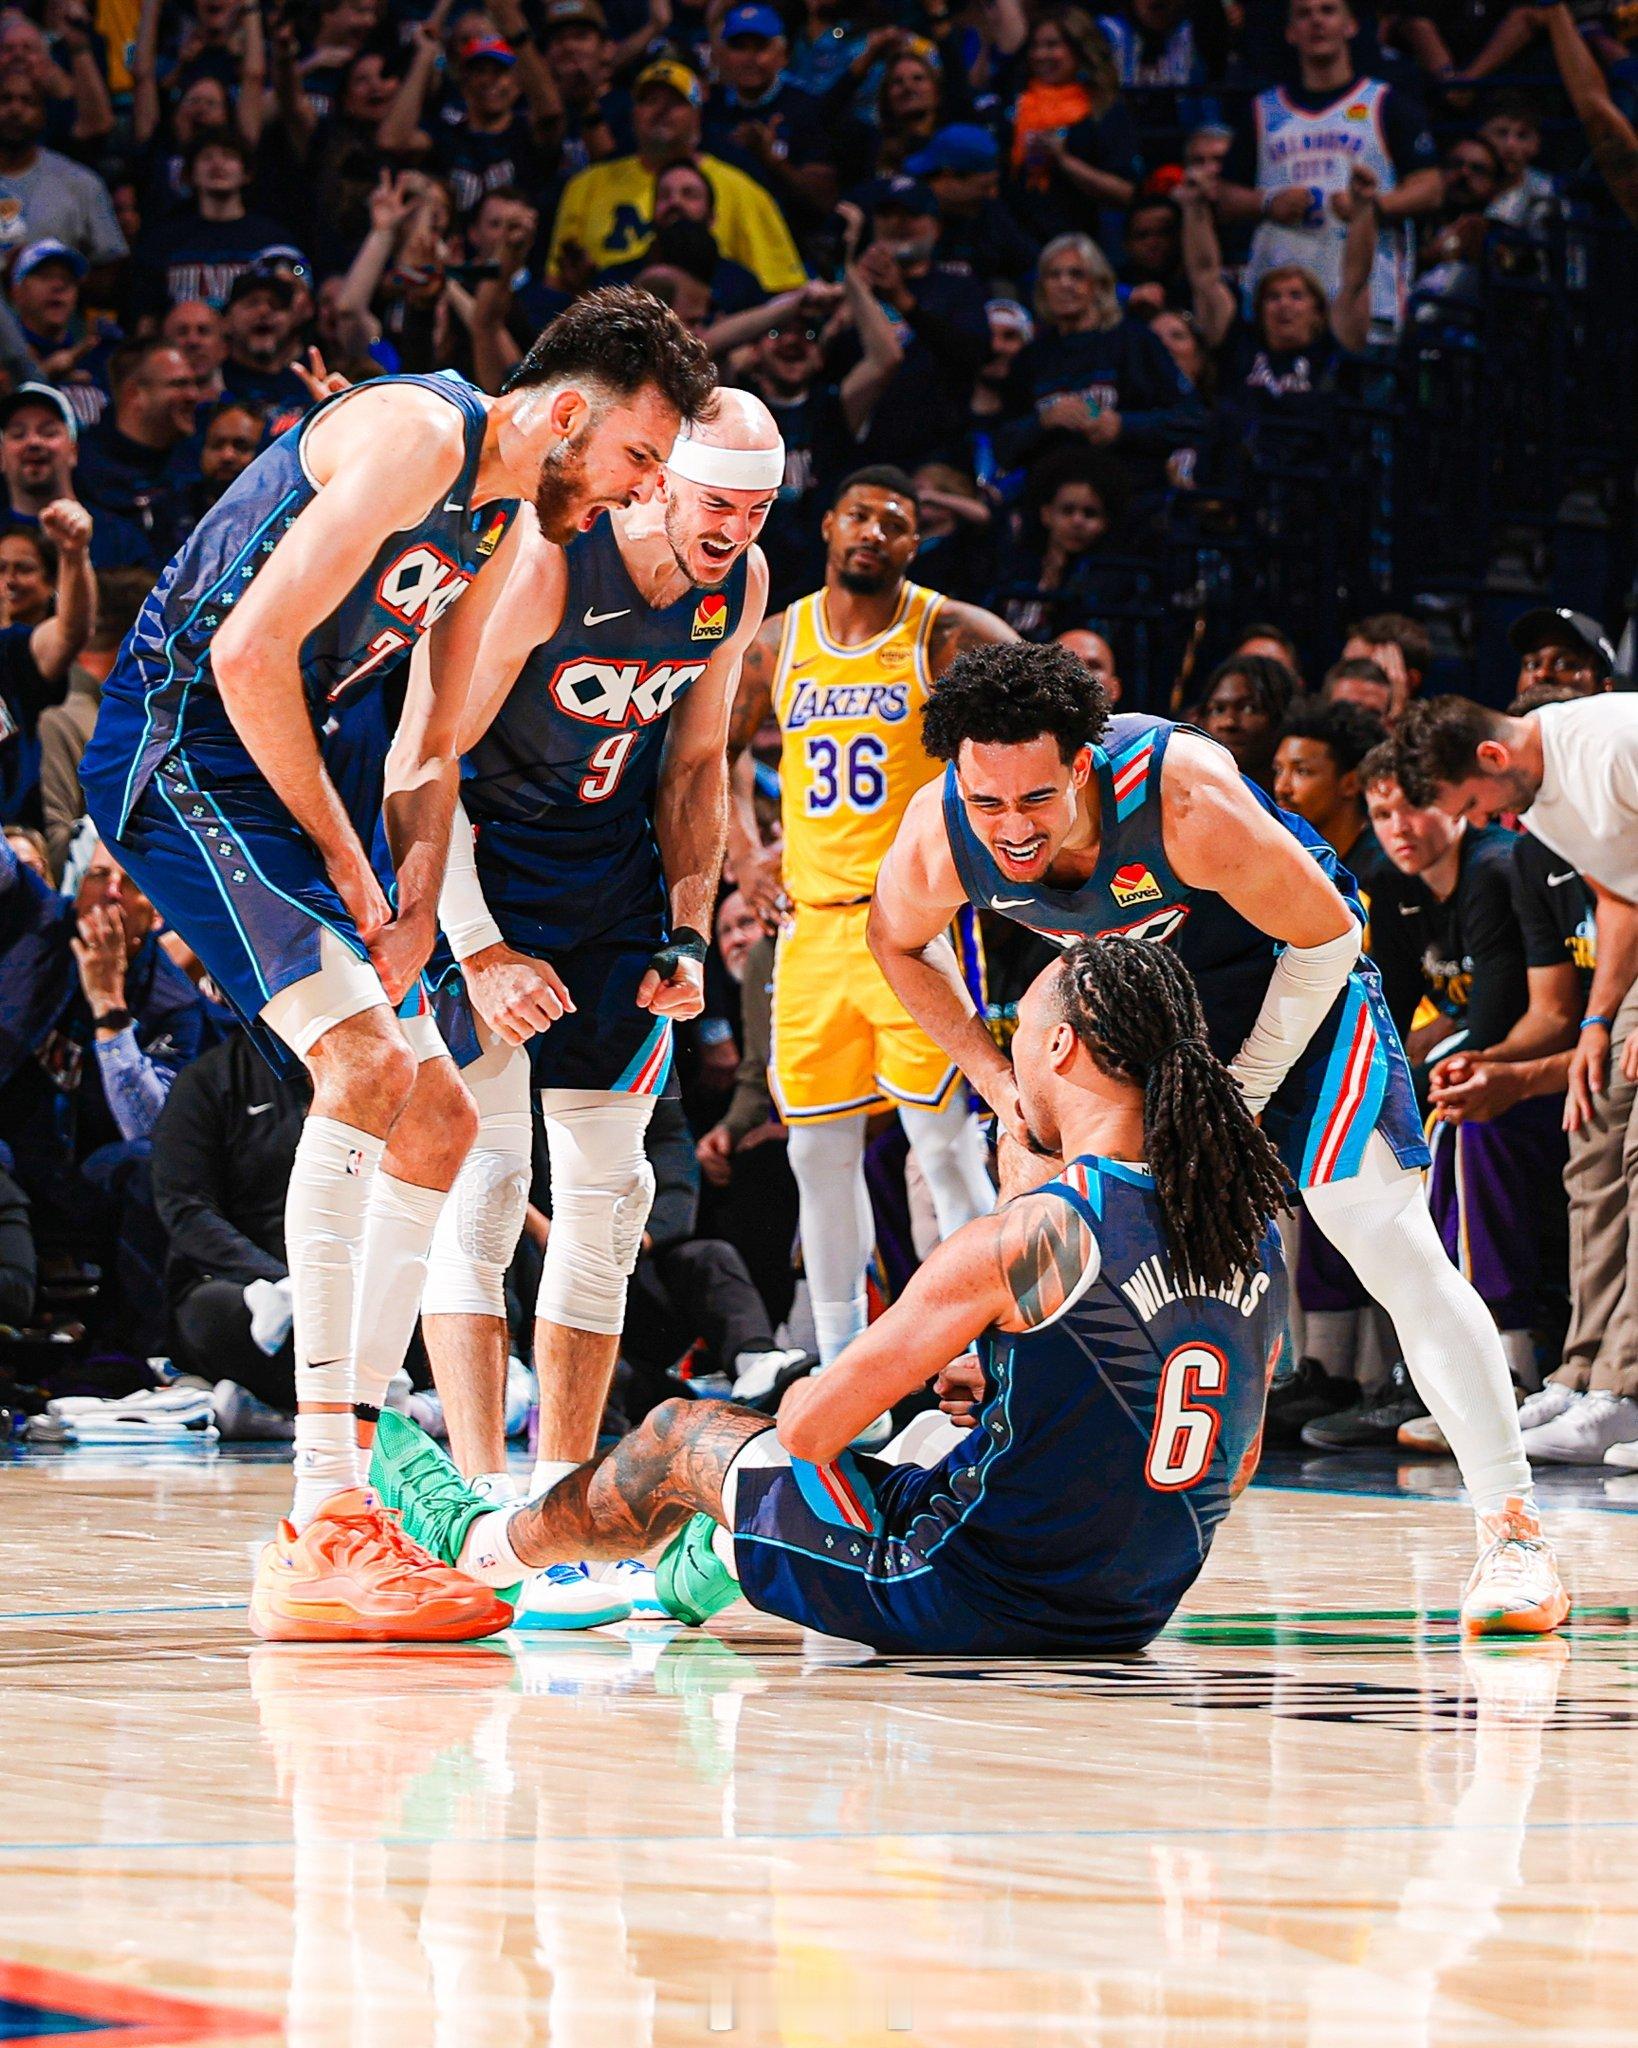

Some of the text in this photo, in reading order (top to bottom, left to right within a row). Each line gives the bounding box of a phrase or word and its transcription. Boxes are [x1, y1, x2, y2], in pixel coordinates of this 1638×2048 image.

[326, 627, 412, 702] 7
[785, 679, 911, 732] LAKERS
[578, 731, 638, 803] 9
[806, 735, 887, 815] 36
[1144, 1341, 1230, 1493] 6
